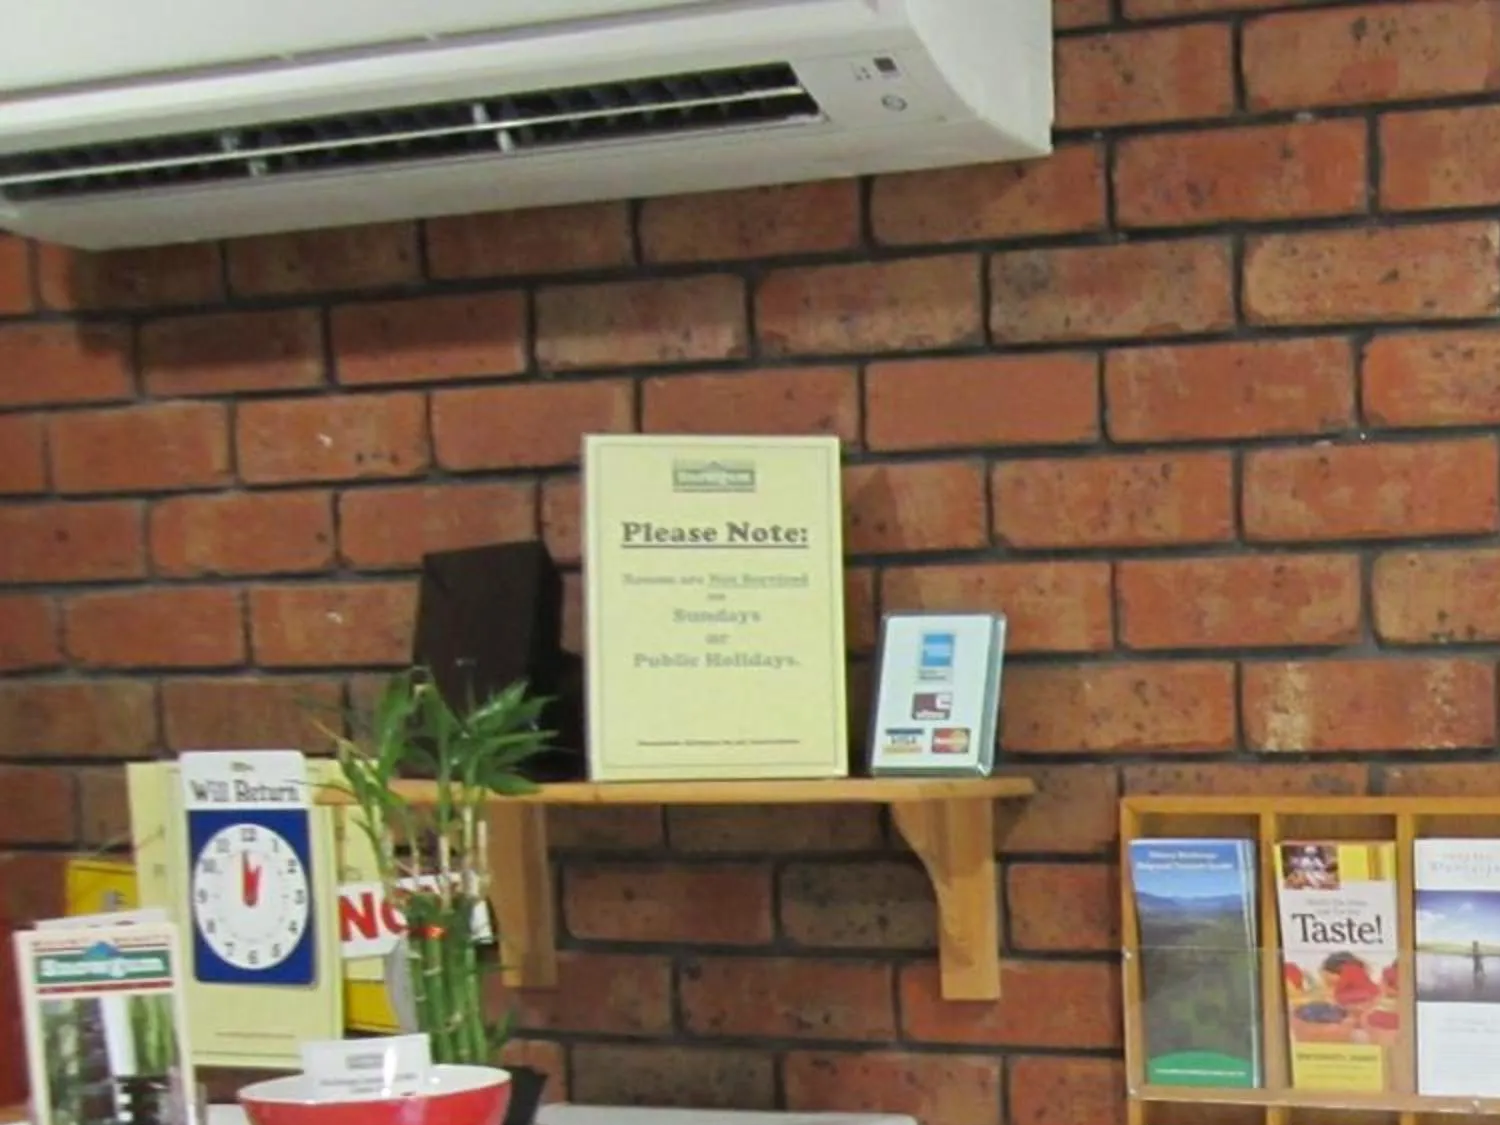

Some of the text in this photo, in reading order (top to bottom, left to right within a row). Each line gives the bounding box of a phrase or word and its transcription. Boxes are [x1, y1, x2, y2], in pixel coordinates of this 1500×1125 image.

[621, 522, 808, 544] Please Note:
[672, 608, 762, 626] Sundays
[633, 653, 700, 669] Public
[233, 779, 300, 802] Return
[1292, 913, 1384, 945] Taste!
